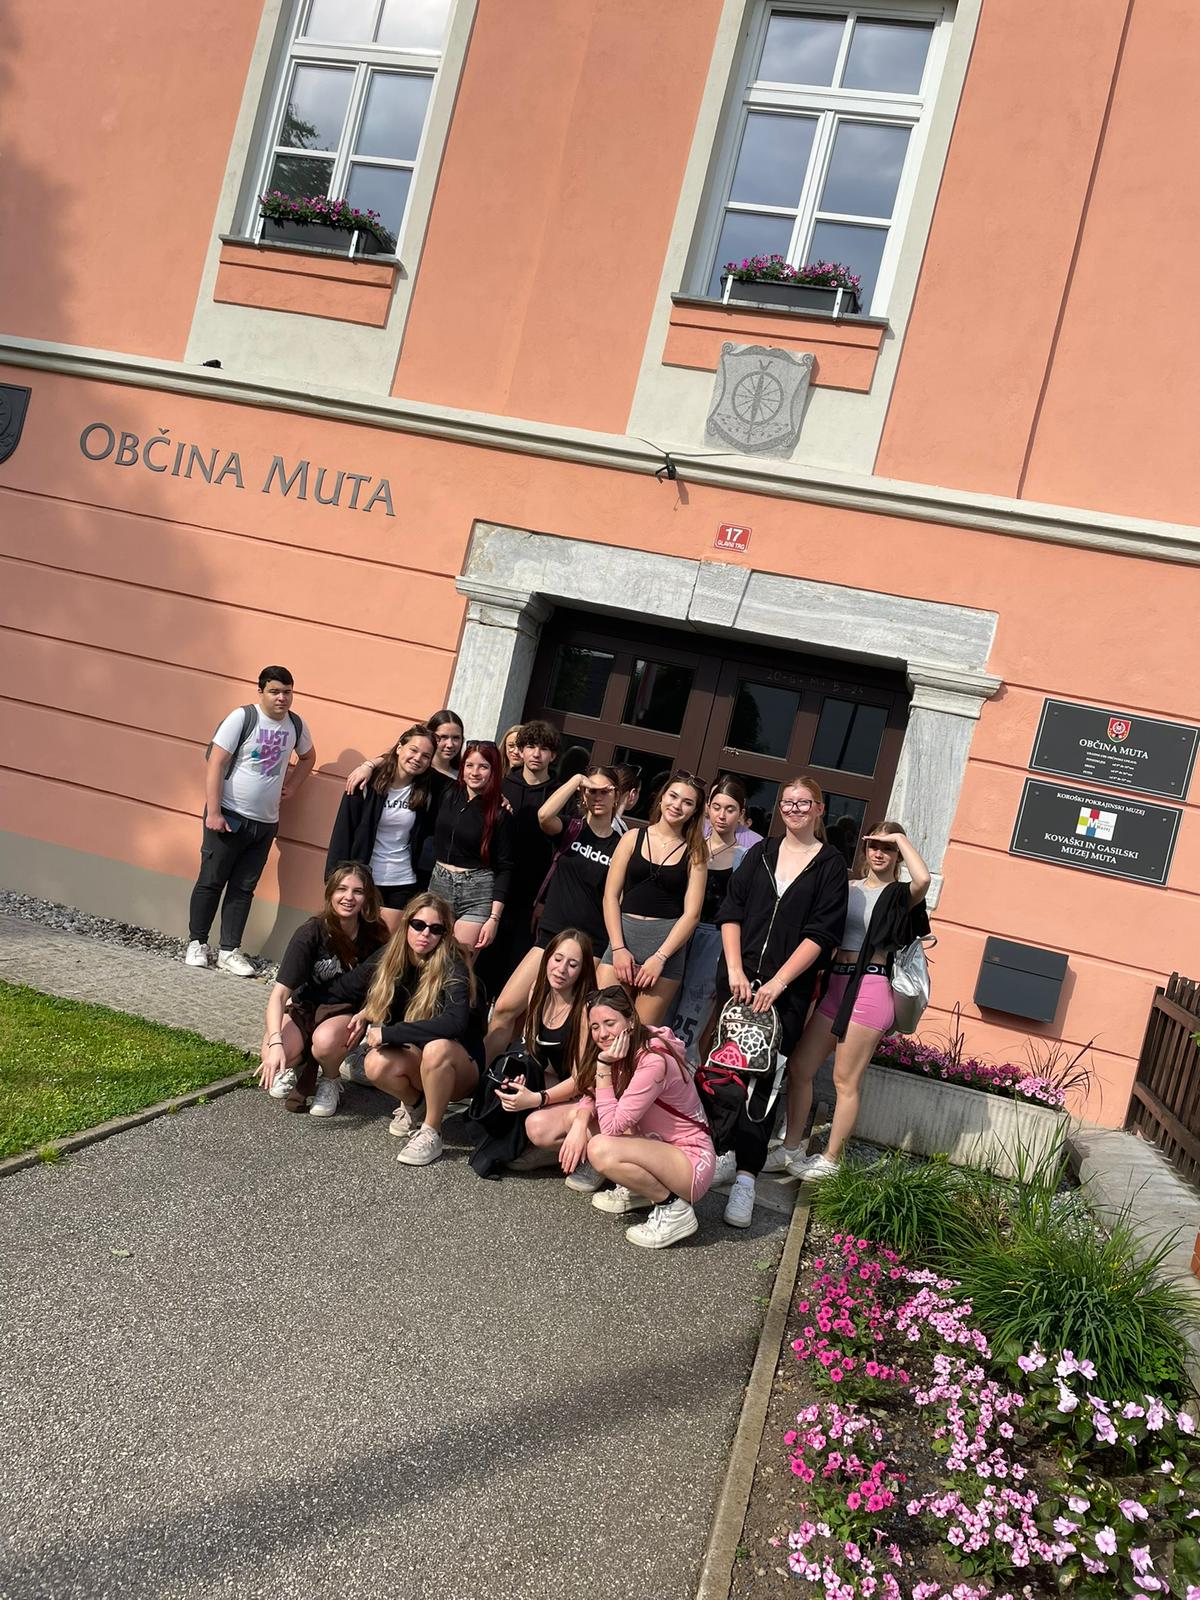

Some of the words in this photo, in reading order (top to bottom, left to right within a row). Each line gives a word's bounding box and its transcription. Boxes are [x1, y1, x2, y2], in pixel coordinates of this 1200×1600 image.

[80, 423, 245, 488] OBČINA
[262, 455, 396, 517] MUTA
[725, 527, 743, 542] 17
[256, 729, 289, 746] JUST
[1079, 738, 1117, 753] OBČINA
[1119, 746, 1149, 759] MUTA
[383, 800, 410, 810] LFIG
[1056, 792, 1085, 803] KOROŠKI
[1085, 797, 1125, 812] POKRAJINSKI
[1125, 806, 1146, 816] MUZEJ
[1044, 832, 1084, 848] KOVAŠKI
[1085, 841, 1096, 850] IN
[1097, 844, 1139, 859] GASILSKI
[1061, 846, 1090, 859] MUZEJ
[1090, 852, 1117, 864] MUTA
